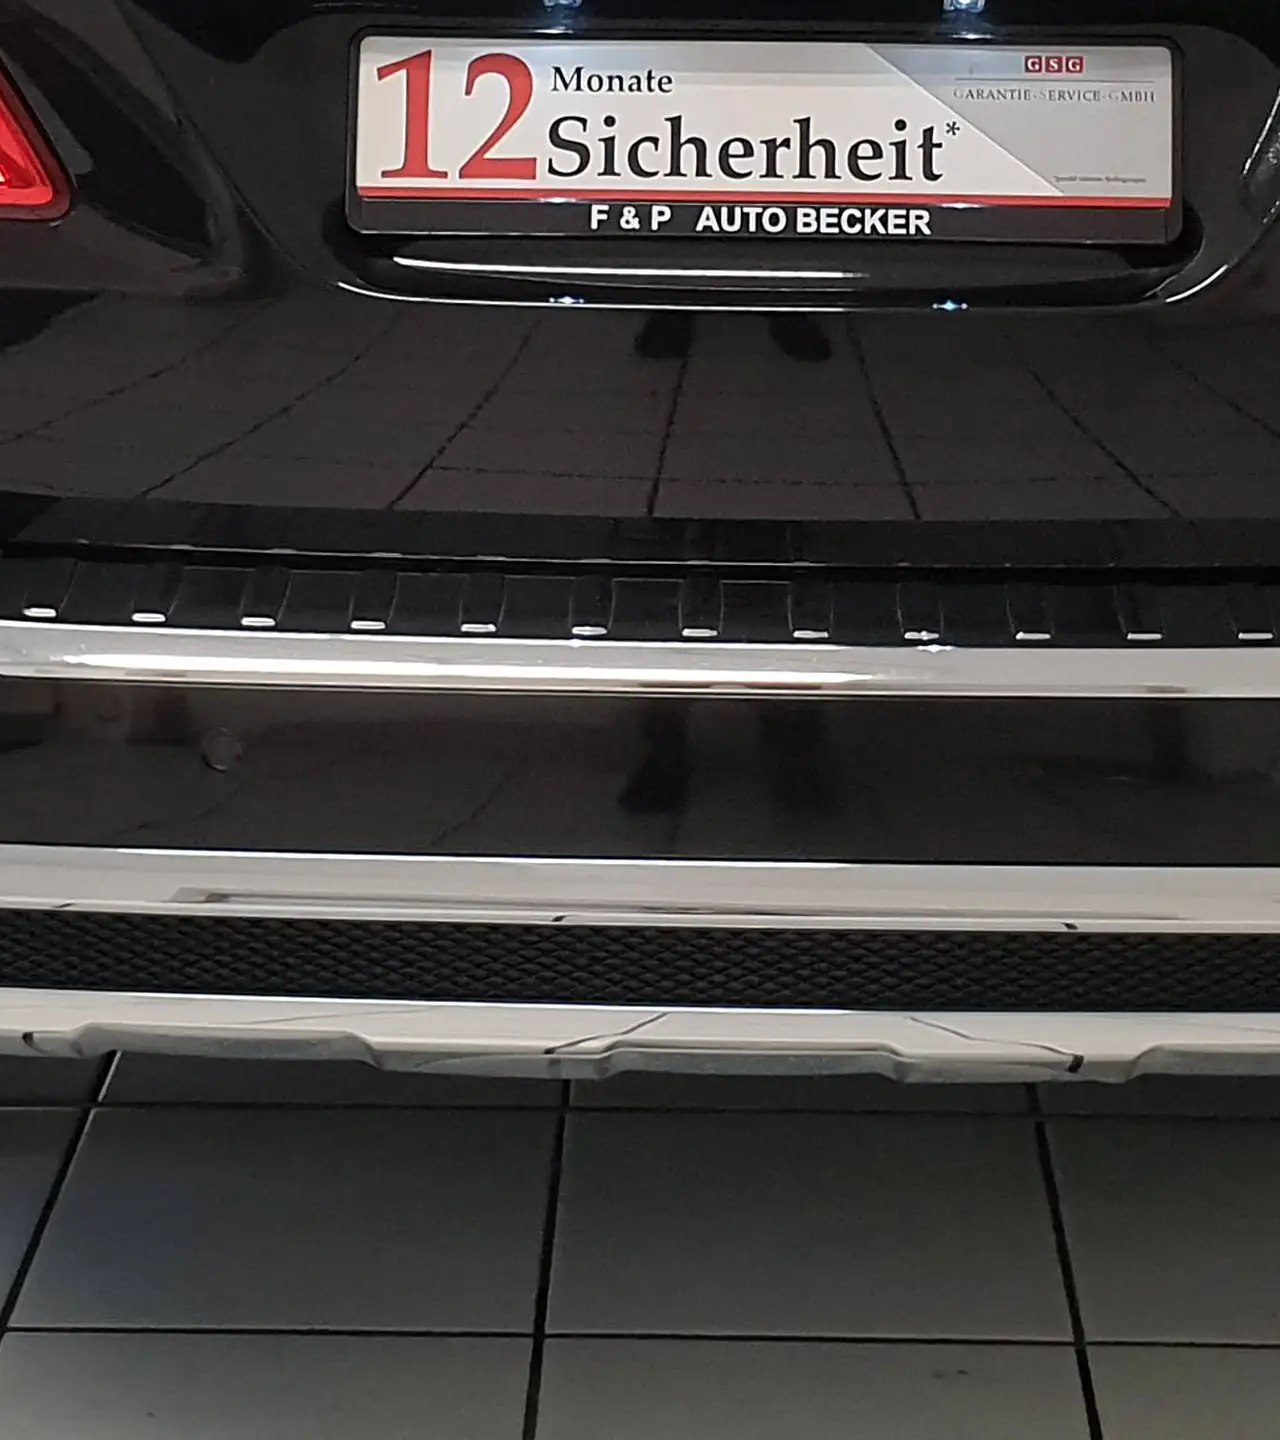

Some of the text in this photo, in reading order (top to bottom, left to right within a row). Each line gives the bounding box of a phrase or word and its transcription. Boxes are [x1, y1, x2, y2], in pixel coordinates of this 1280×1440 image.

[1025, 56, 1084, 73] GSG
[551, 66, 673, 94] Monate
[376, 48, 537, 181] 12
[590, 204, 932, 235] F & P AUTO BECKER
